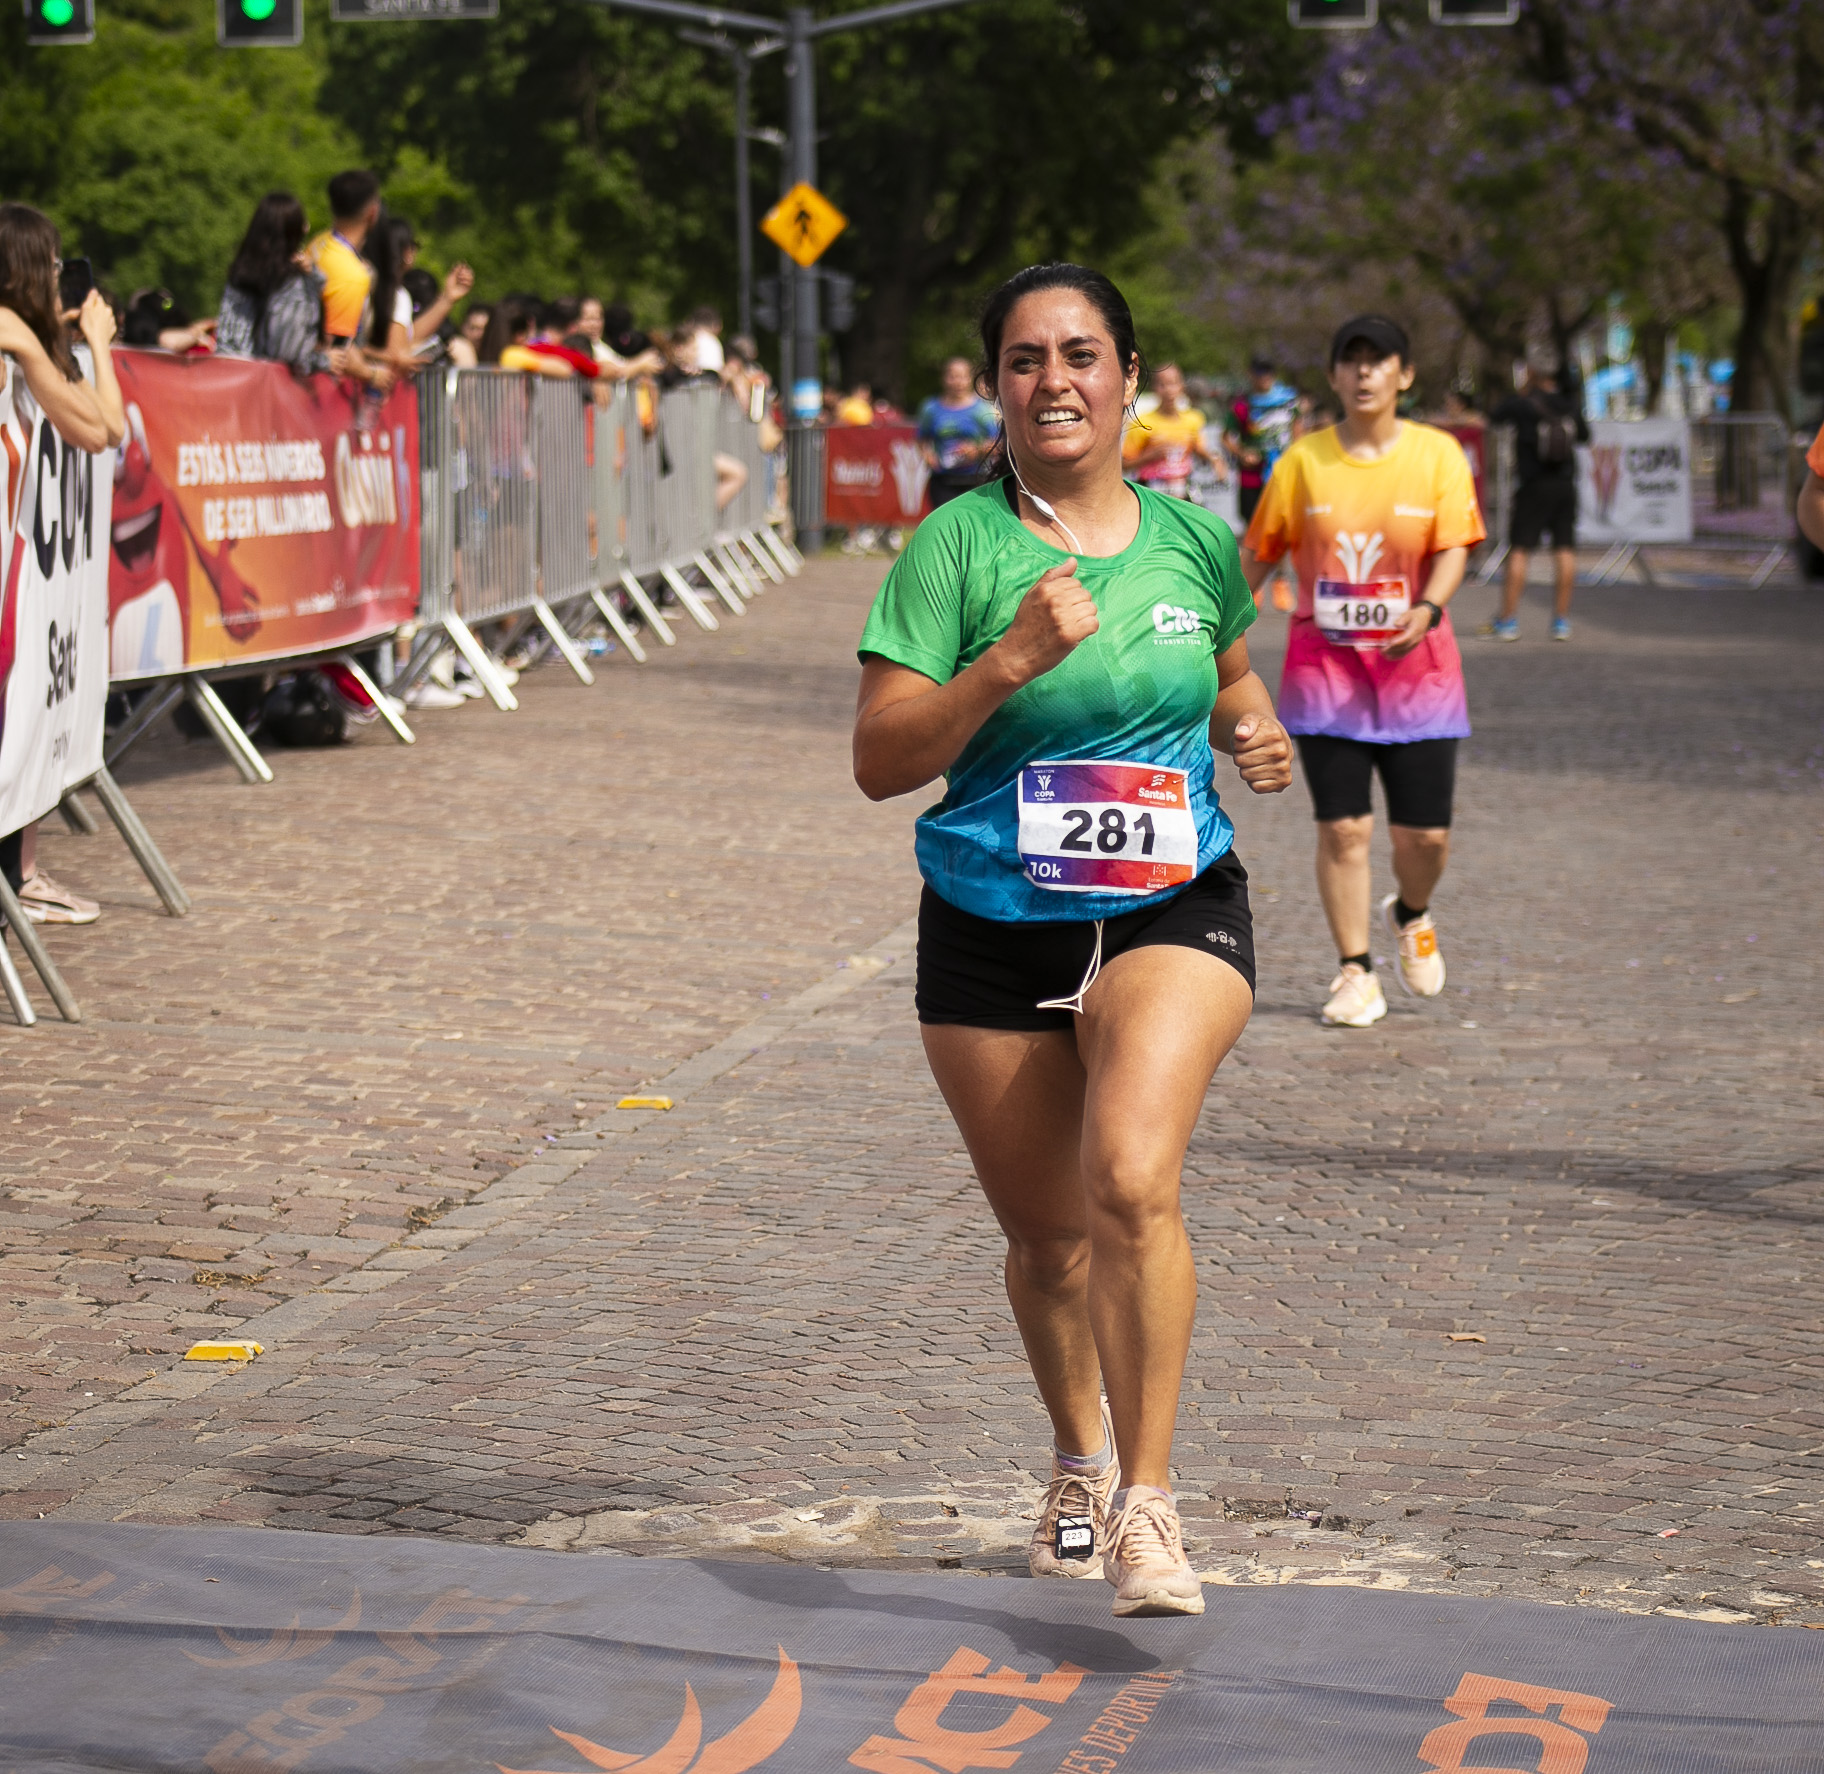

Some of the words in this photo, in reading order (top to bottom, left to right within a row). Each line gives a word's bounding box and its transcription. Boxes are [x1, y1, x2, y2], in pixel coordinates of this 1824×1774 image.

[203, 500, 226, 541] DE
[226, 496, 256, 539] SER
[1338, 603, 1389, 625] 180
[1034, 790, 1056, 798] COPA
[1138, 787, 1166, 801] Santa
[1165, 790, 1178, 803] Fe
[1060, 808, 1156, 856] 281
[1029, 861, 1062, 879] 10k
[1065, 1532, 1083, 1541] 223
